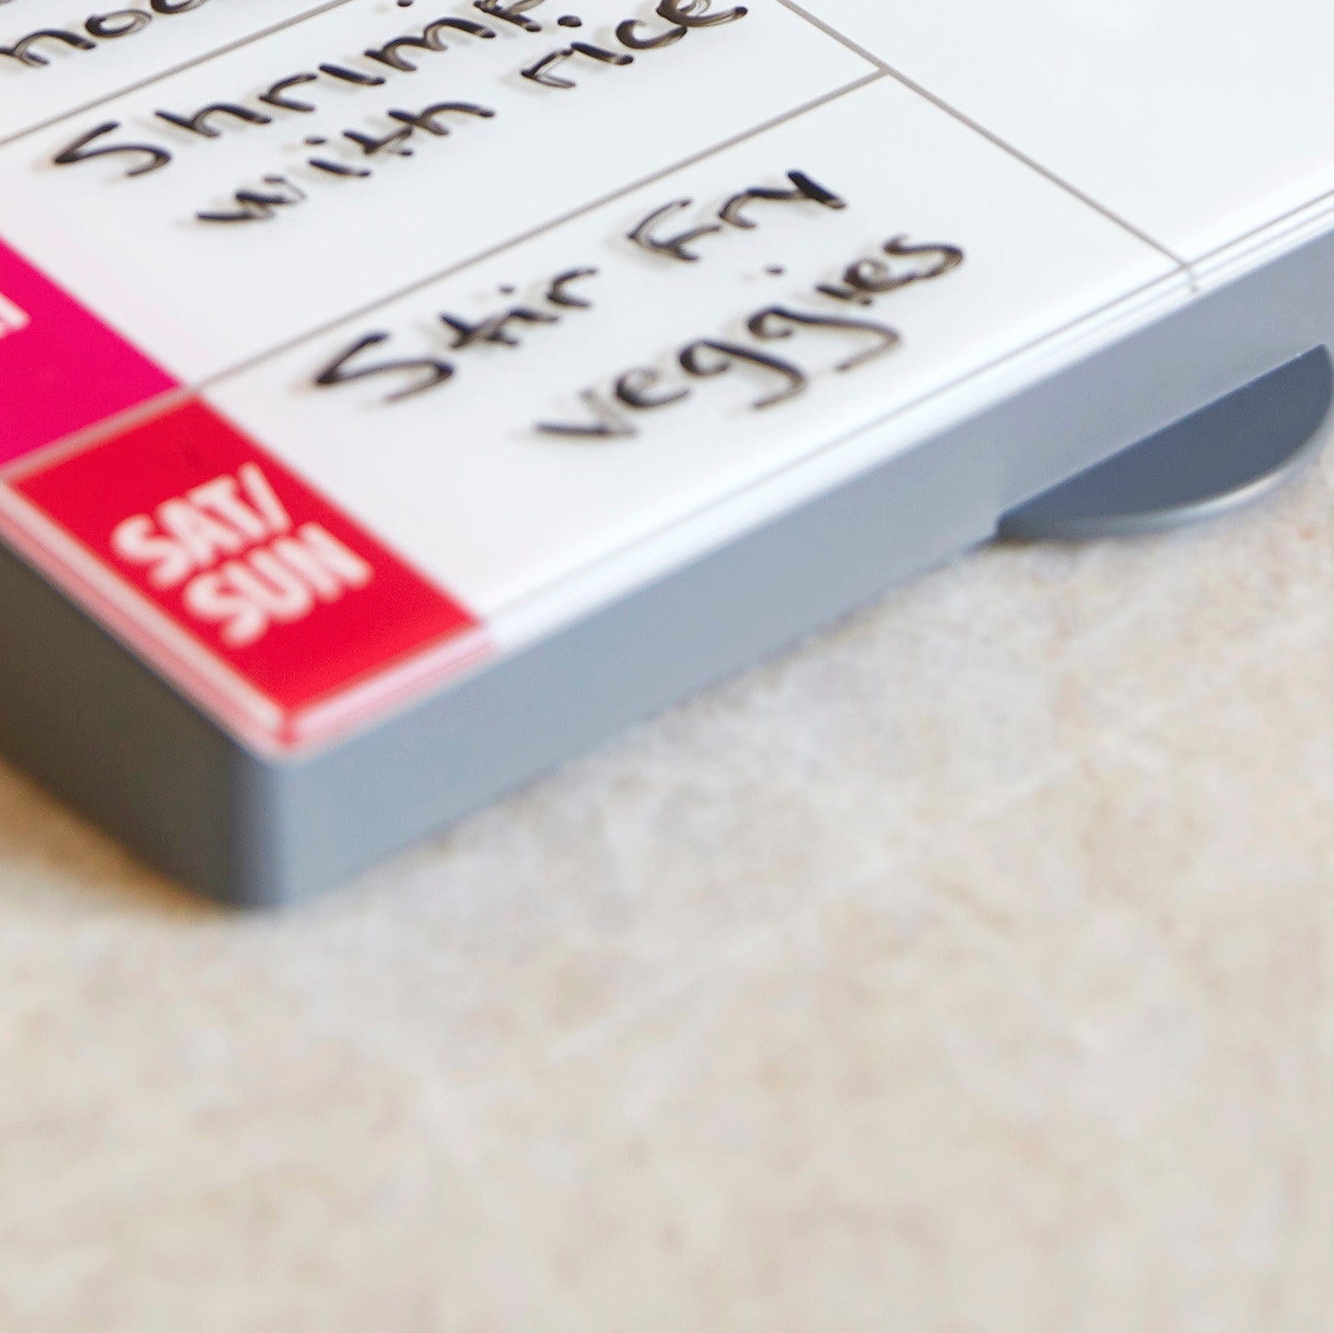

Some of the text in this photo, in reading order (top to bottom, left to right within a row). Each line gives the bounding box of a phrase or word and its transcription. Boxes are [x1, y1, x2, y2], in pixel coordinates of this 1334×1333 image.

[197, 101, 495, 226] with
[315, 267, 599, 403] Stir
[534, 234, 965, 439] veggies
[111, 463, 294, 589] SAT/
[183, 523, 375, 648] SUN
